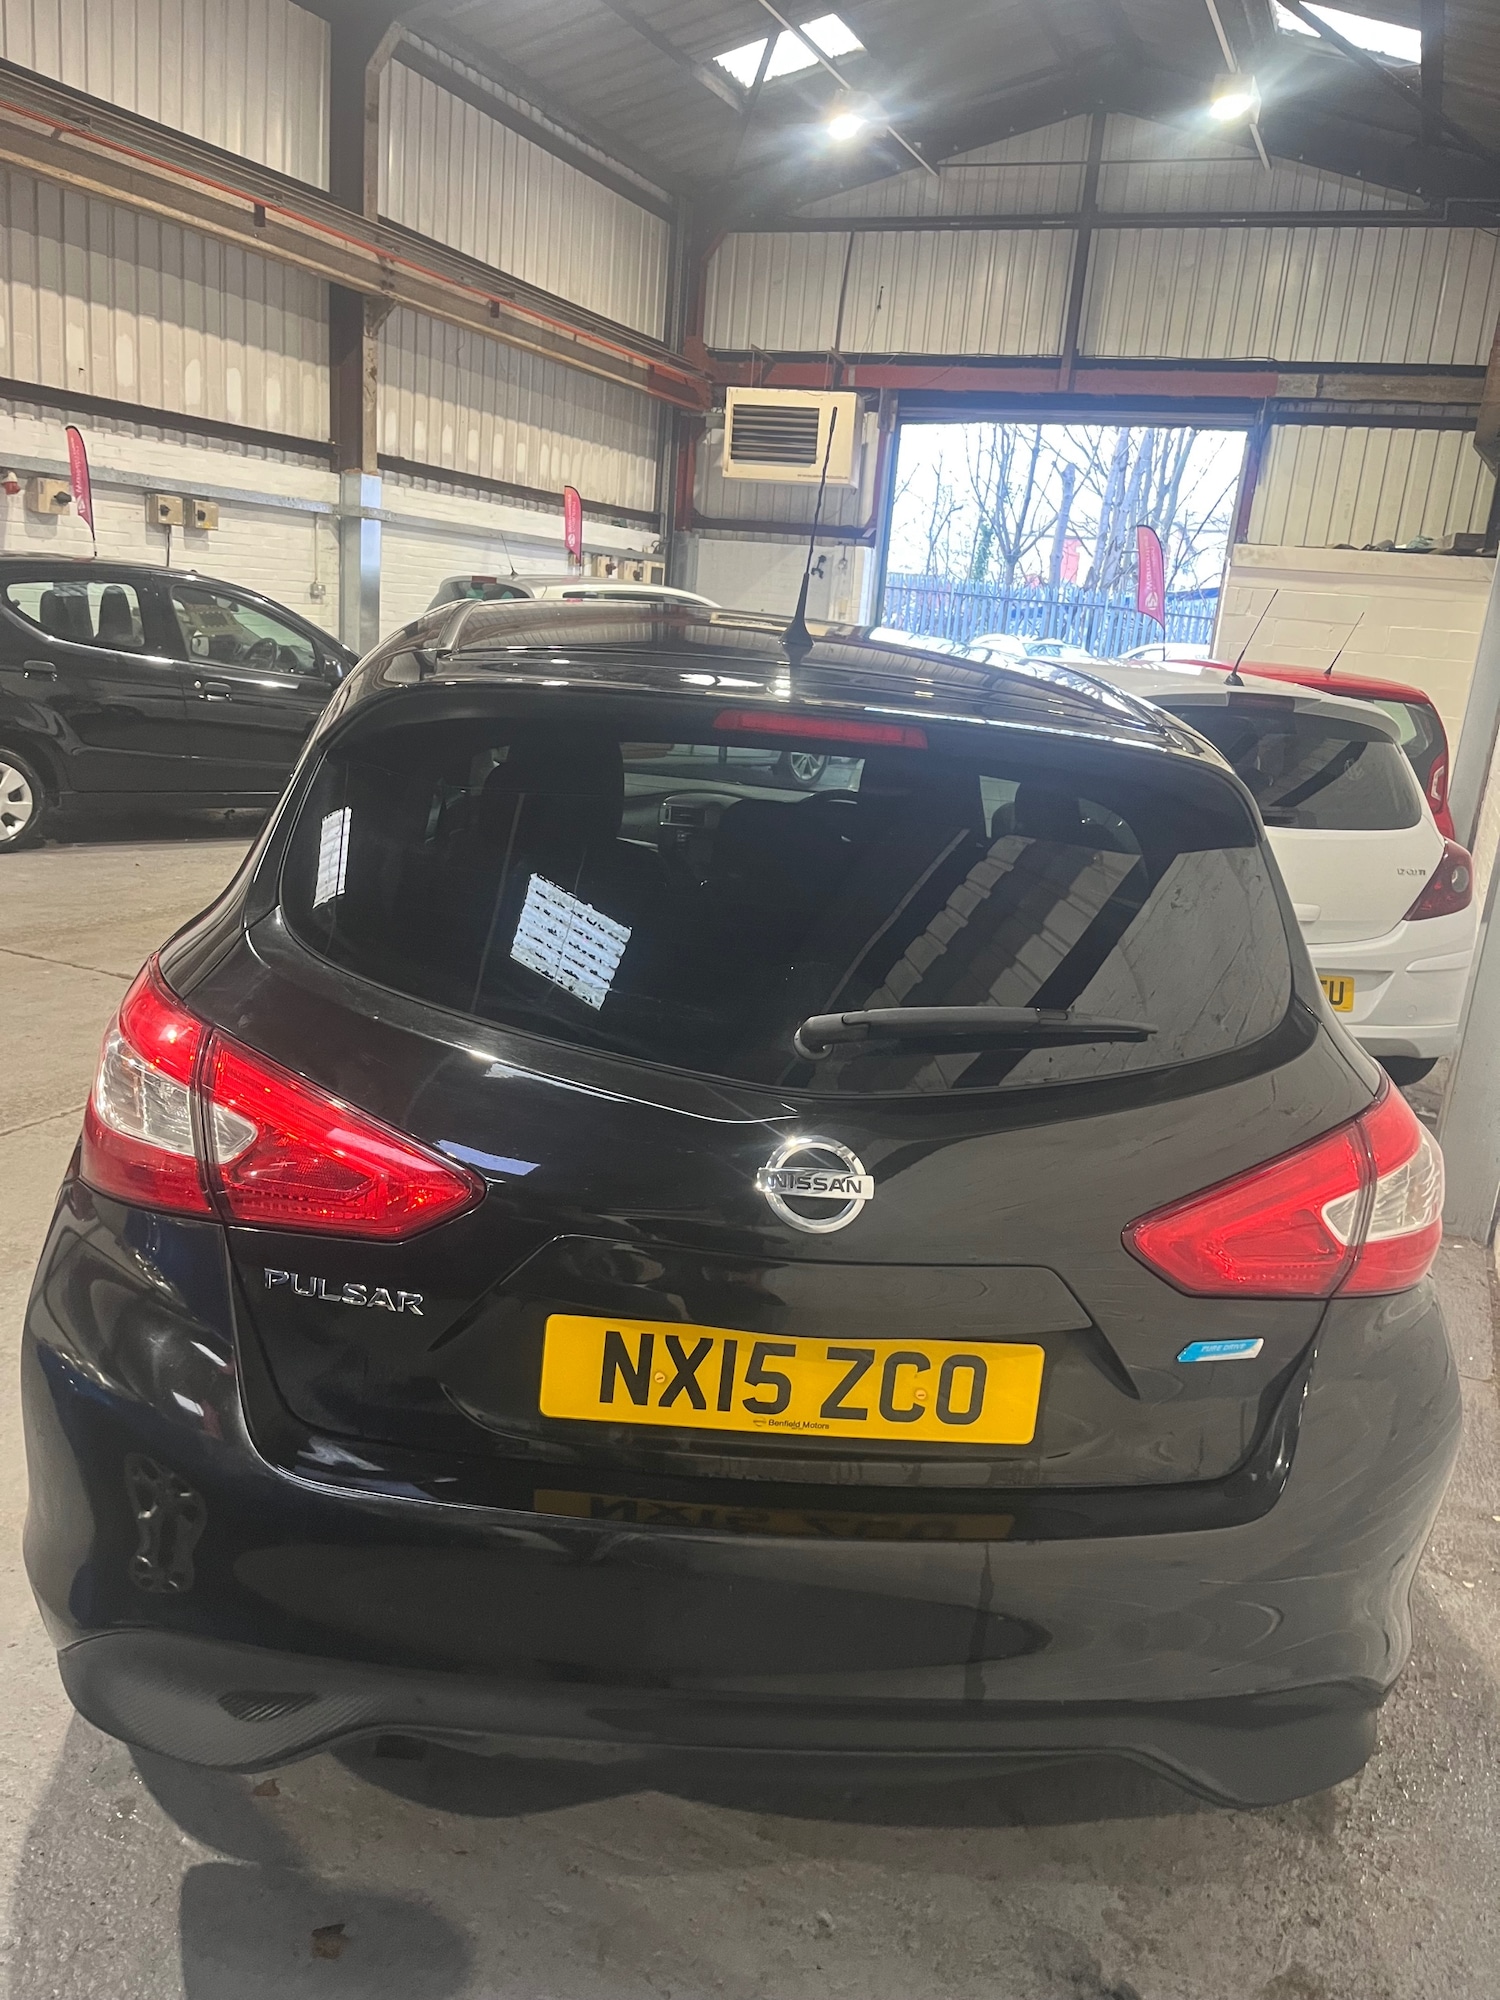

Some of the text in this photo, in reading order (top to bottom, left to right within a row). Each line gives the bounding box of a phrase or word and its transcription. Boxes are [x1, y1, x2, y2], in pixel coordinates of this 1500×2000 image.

[1320, 980, 1344, 1005] U
[768, 1174, 862, 1194] NISSAN
[263, 1267, 425, 1316] PULSAR
[599, 1330, 988, 1425] NX15 ZCO
[768, 1418, 801, 1428] Benfield
[802, 1421, 830, 1430] Motors
